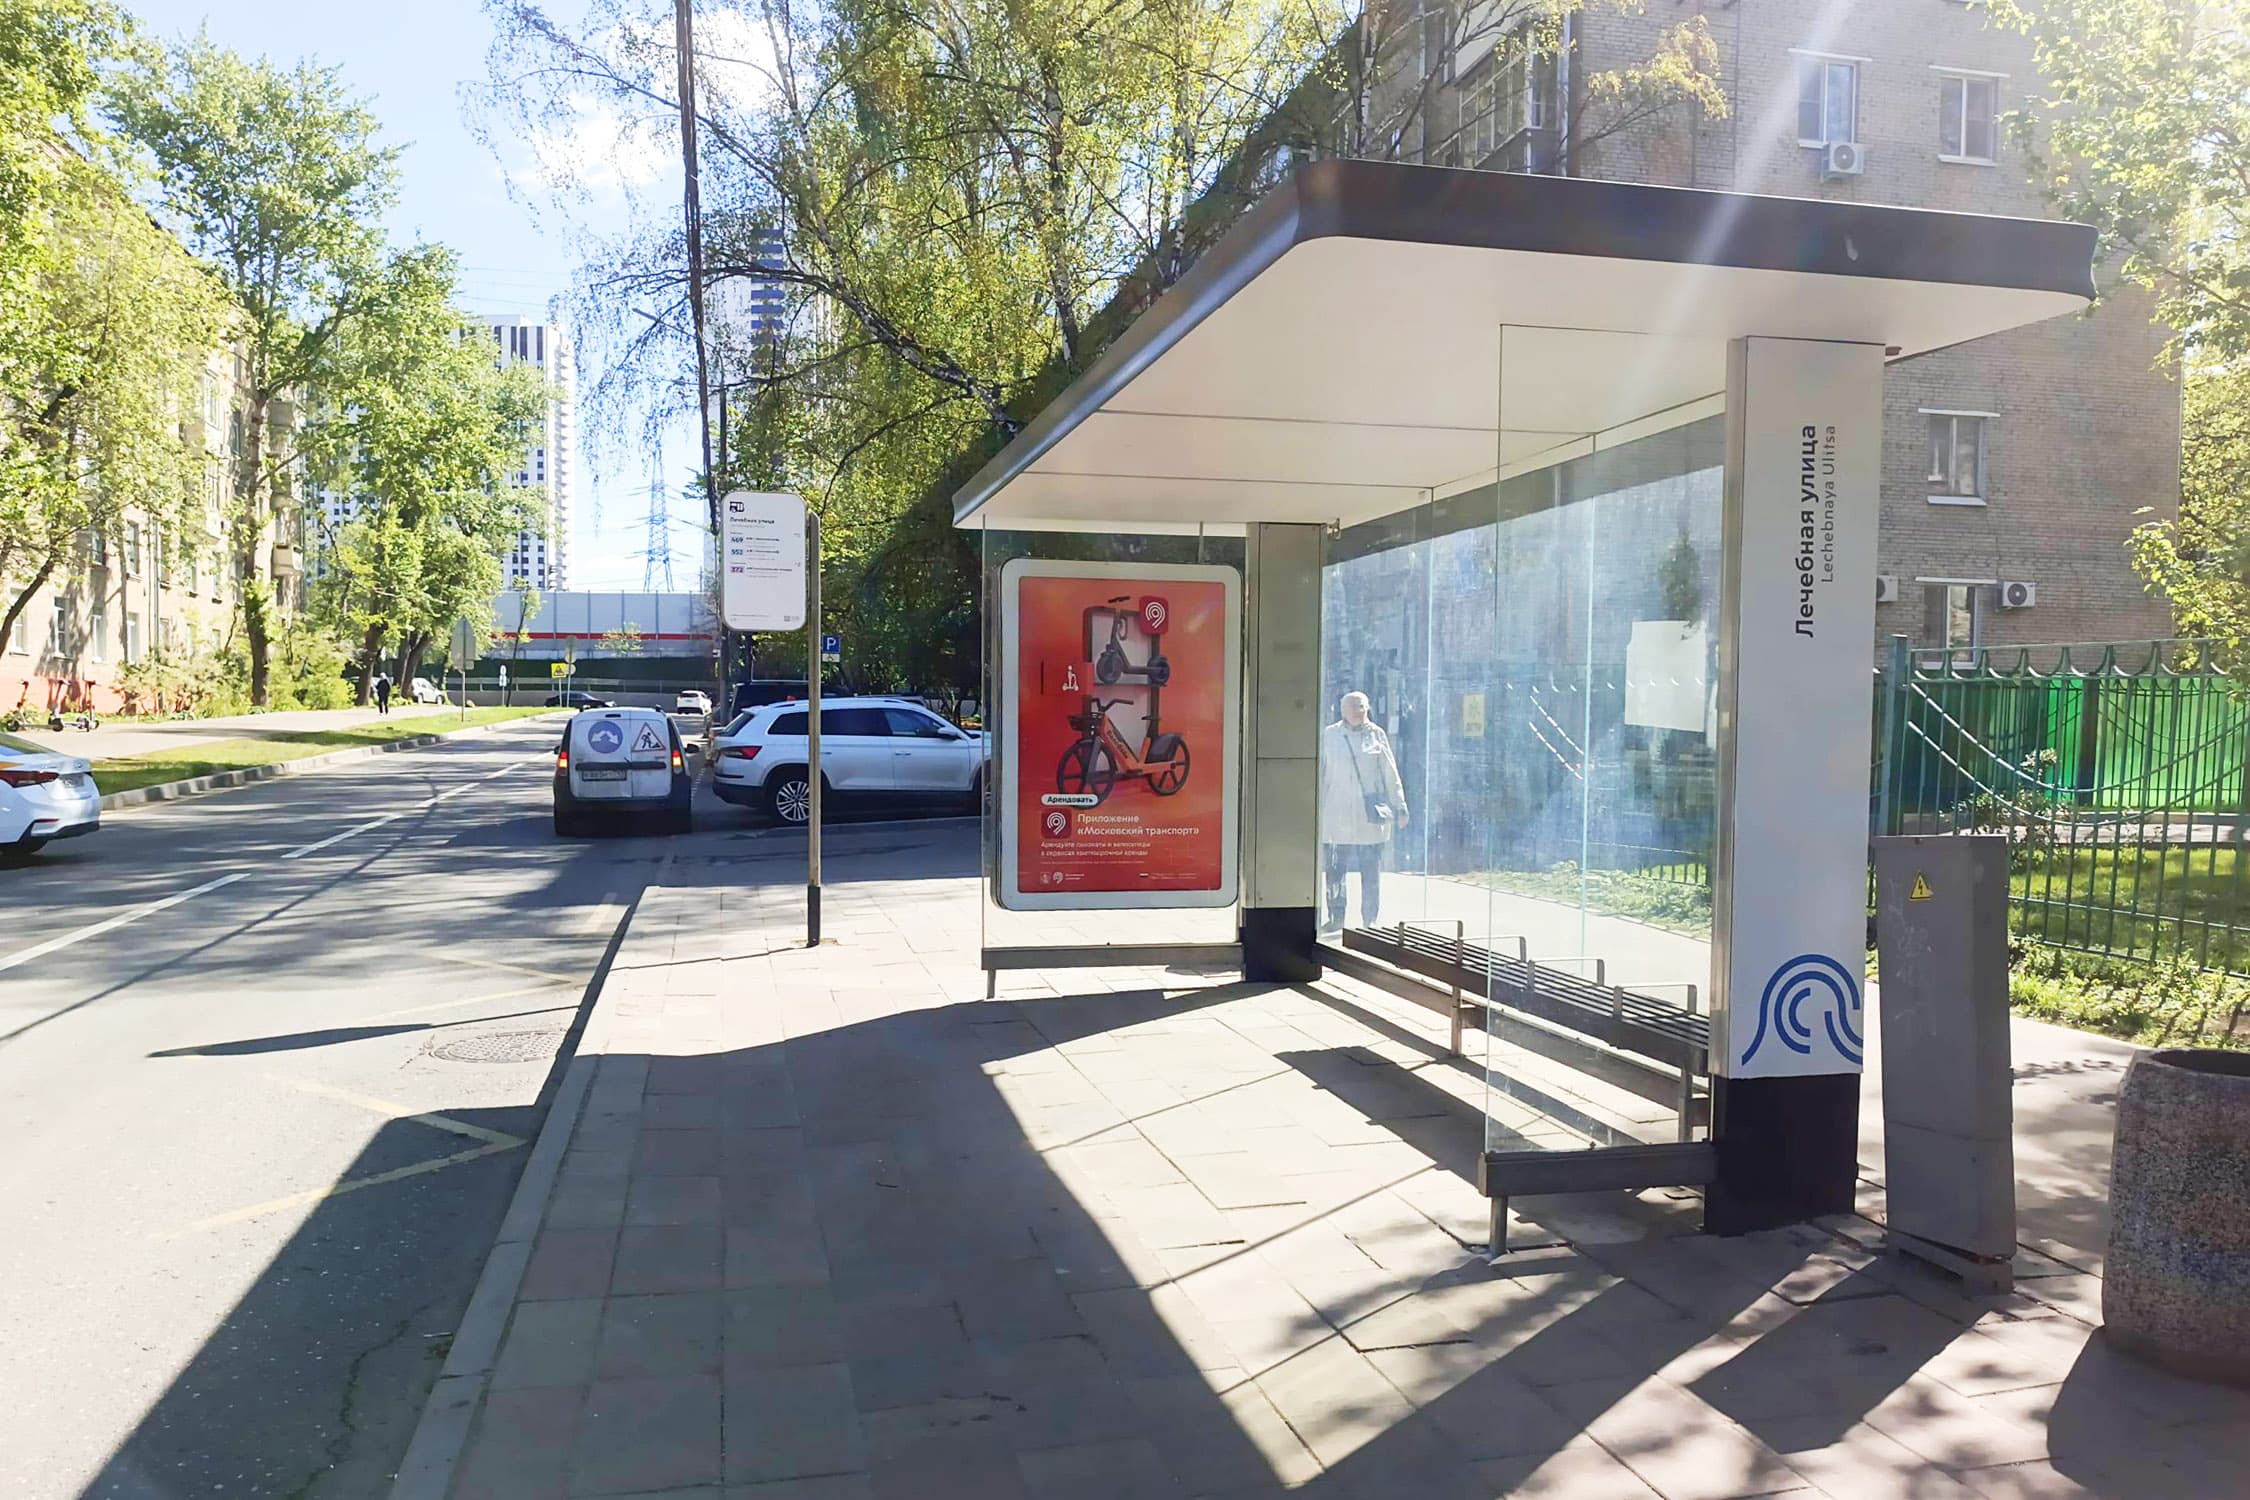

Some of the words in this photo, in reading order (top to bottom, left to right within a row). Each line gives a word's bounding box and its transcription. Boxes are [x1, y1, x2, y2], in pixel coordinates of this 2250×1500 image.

[1801, 425, 1819, 503] улица
[1821, 425, 1836, 475] Ulitsa
[1821, 481, 1837, 583] Lechebnaya
[1795, 510, 1815, 638] Лечебная
[827, 637, 836, 650] P
[1046, 796, 1094, 804] Арендовать
[1077, 813, 1140, 824] Приложение
[1077, 826, 1144, 836] «Московский
[1145, 827, 1199, 837] транспорт»
